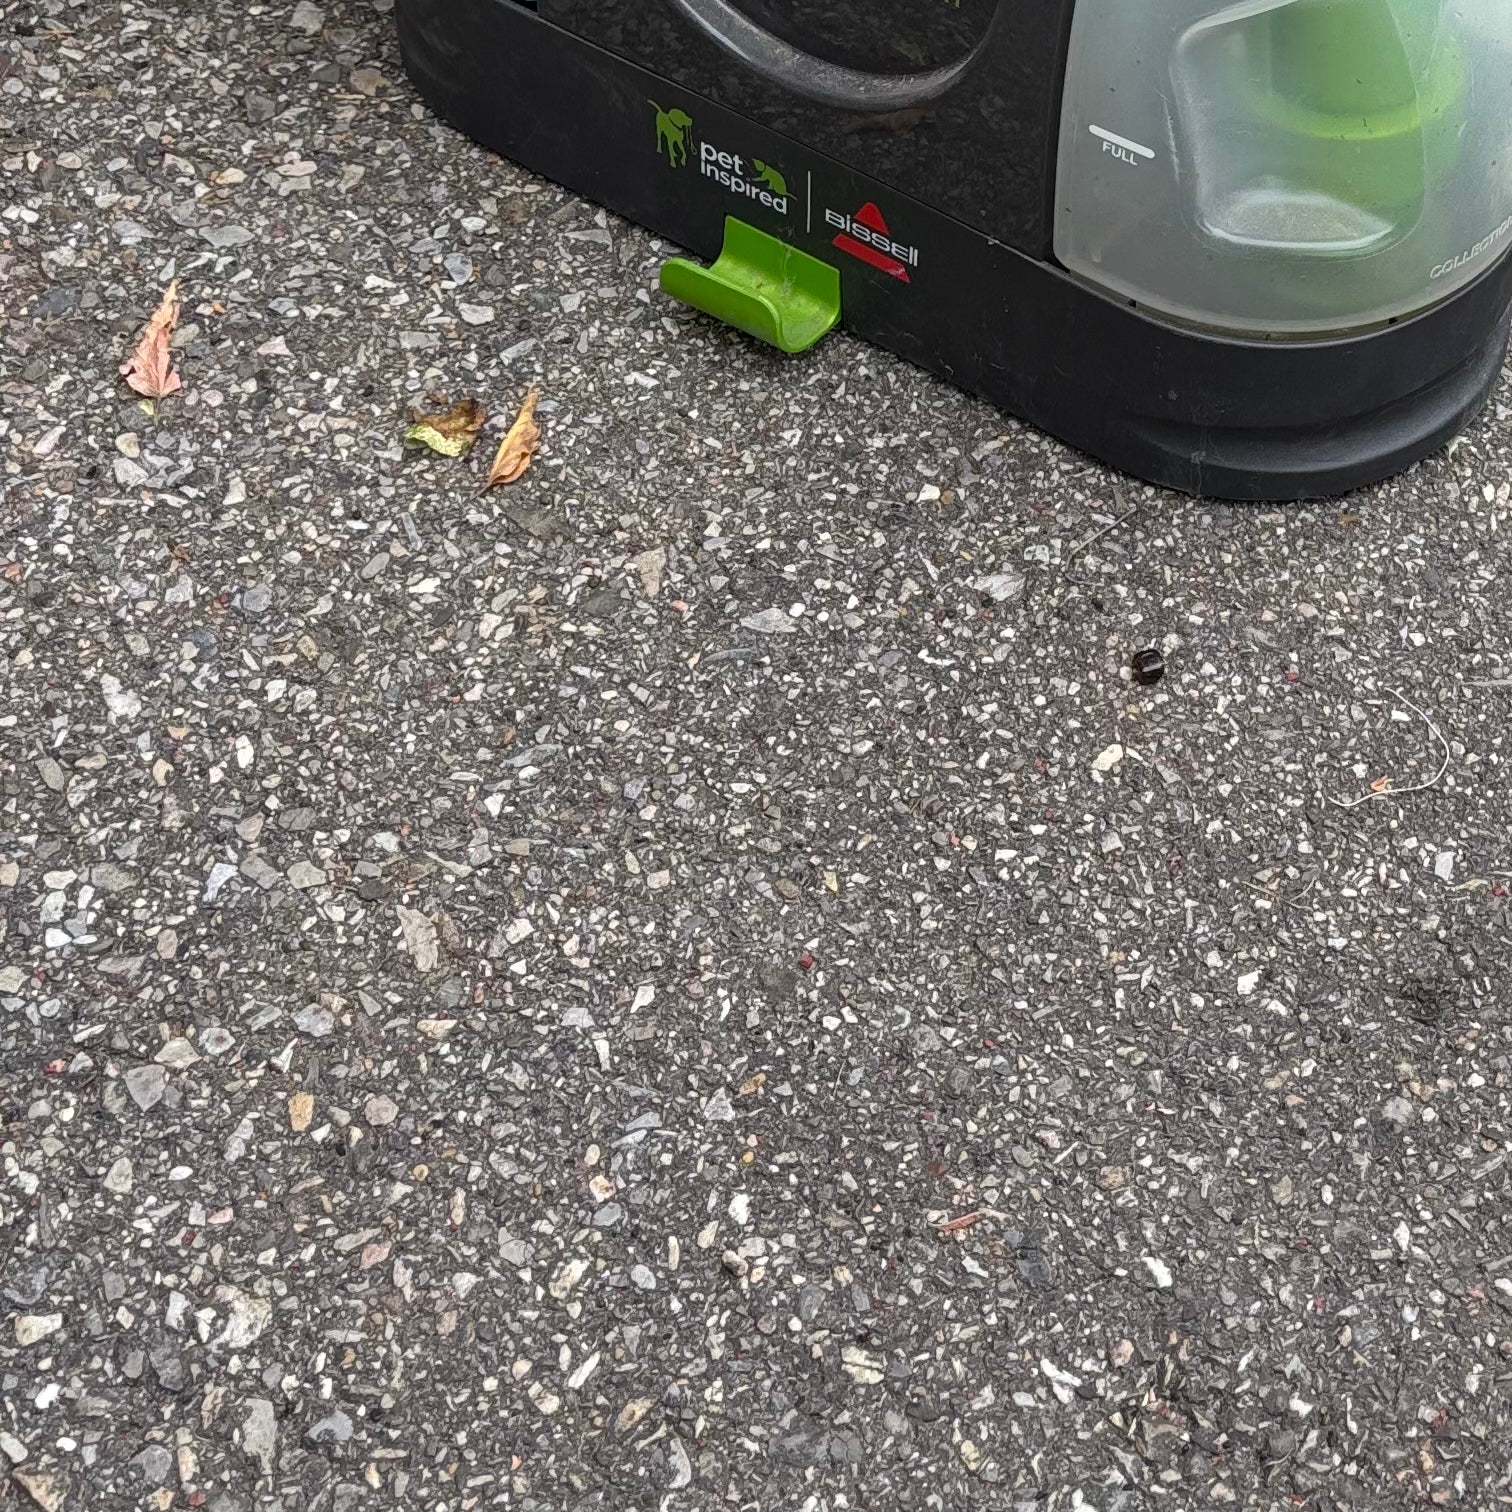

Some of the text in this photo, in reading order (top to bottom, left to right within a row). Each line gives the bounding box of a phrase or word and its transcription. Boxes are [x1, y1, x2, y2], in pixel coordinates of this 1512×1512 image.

[700, 140, 743, 176] pet
[1101, 141, 1139, 167] FULL
[700, 160, 787, 215] inspired
